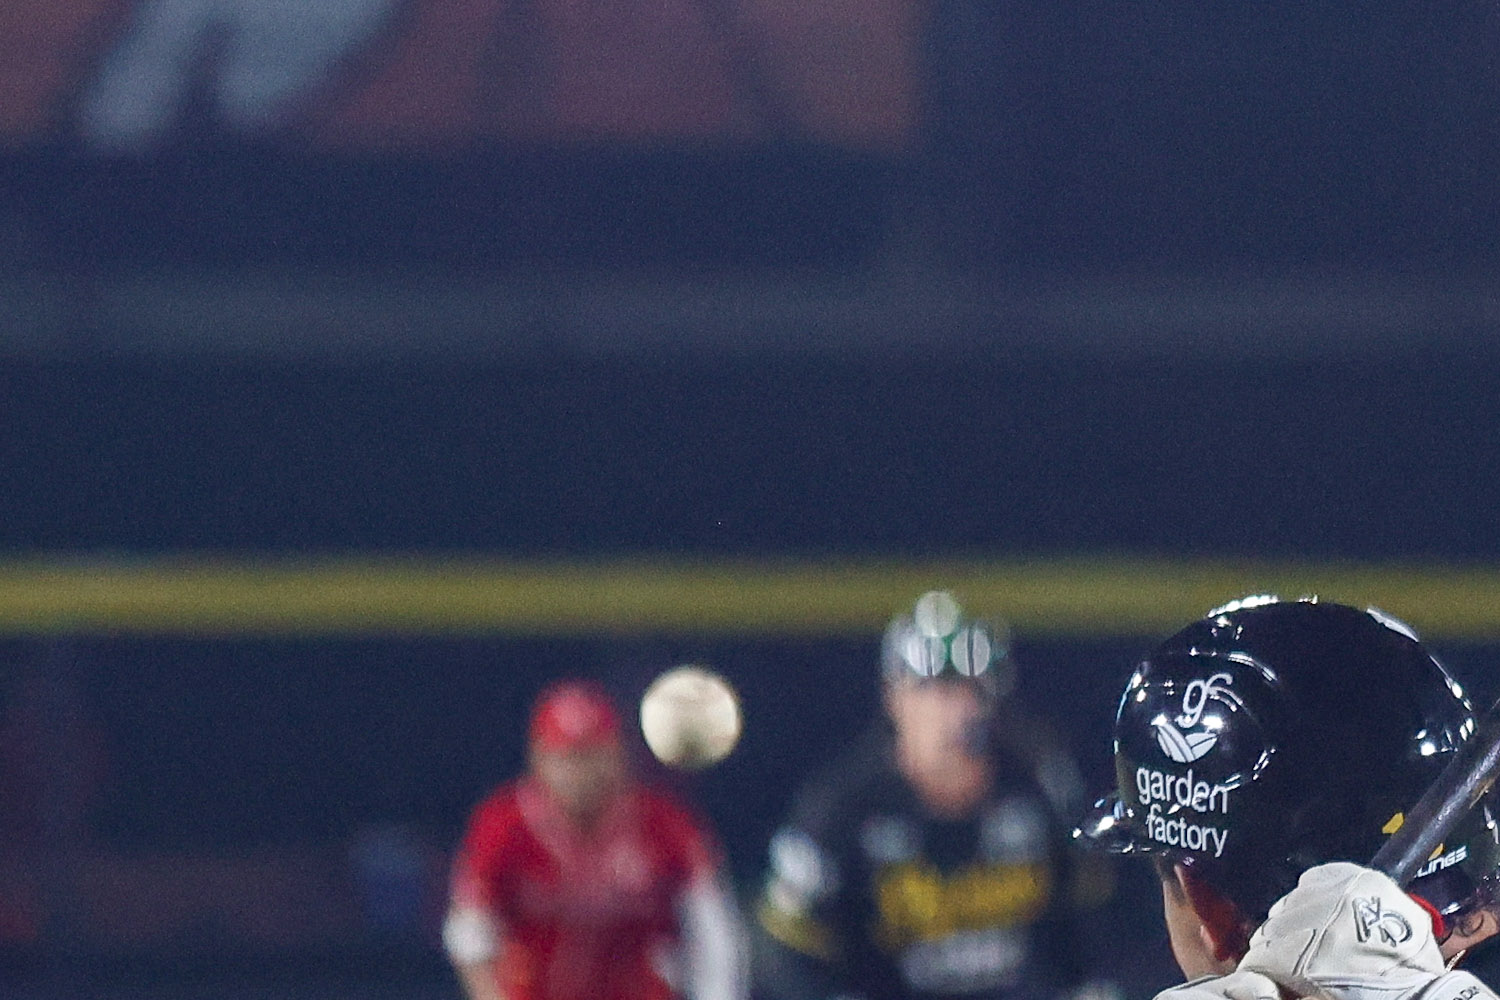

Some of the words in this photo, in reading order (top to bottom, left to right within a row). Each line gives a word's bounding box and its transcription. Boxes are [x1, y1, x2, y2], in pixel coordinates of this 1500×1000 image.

[1136, 767, 1229, 815] garden
[1145, 803, 1229, 858] factory
[1413, 845, 1468, 878] LINGS
